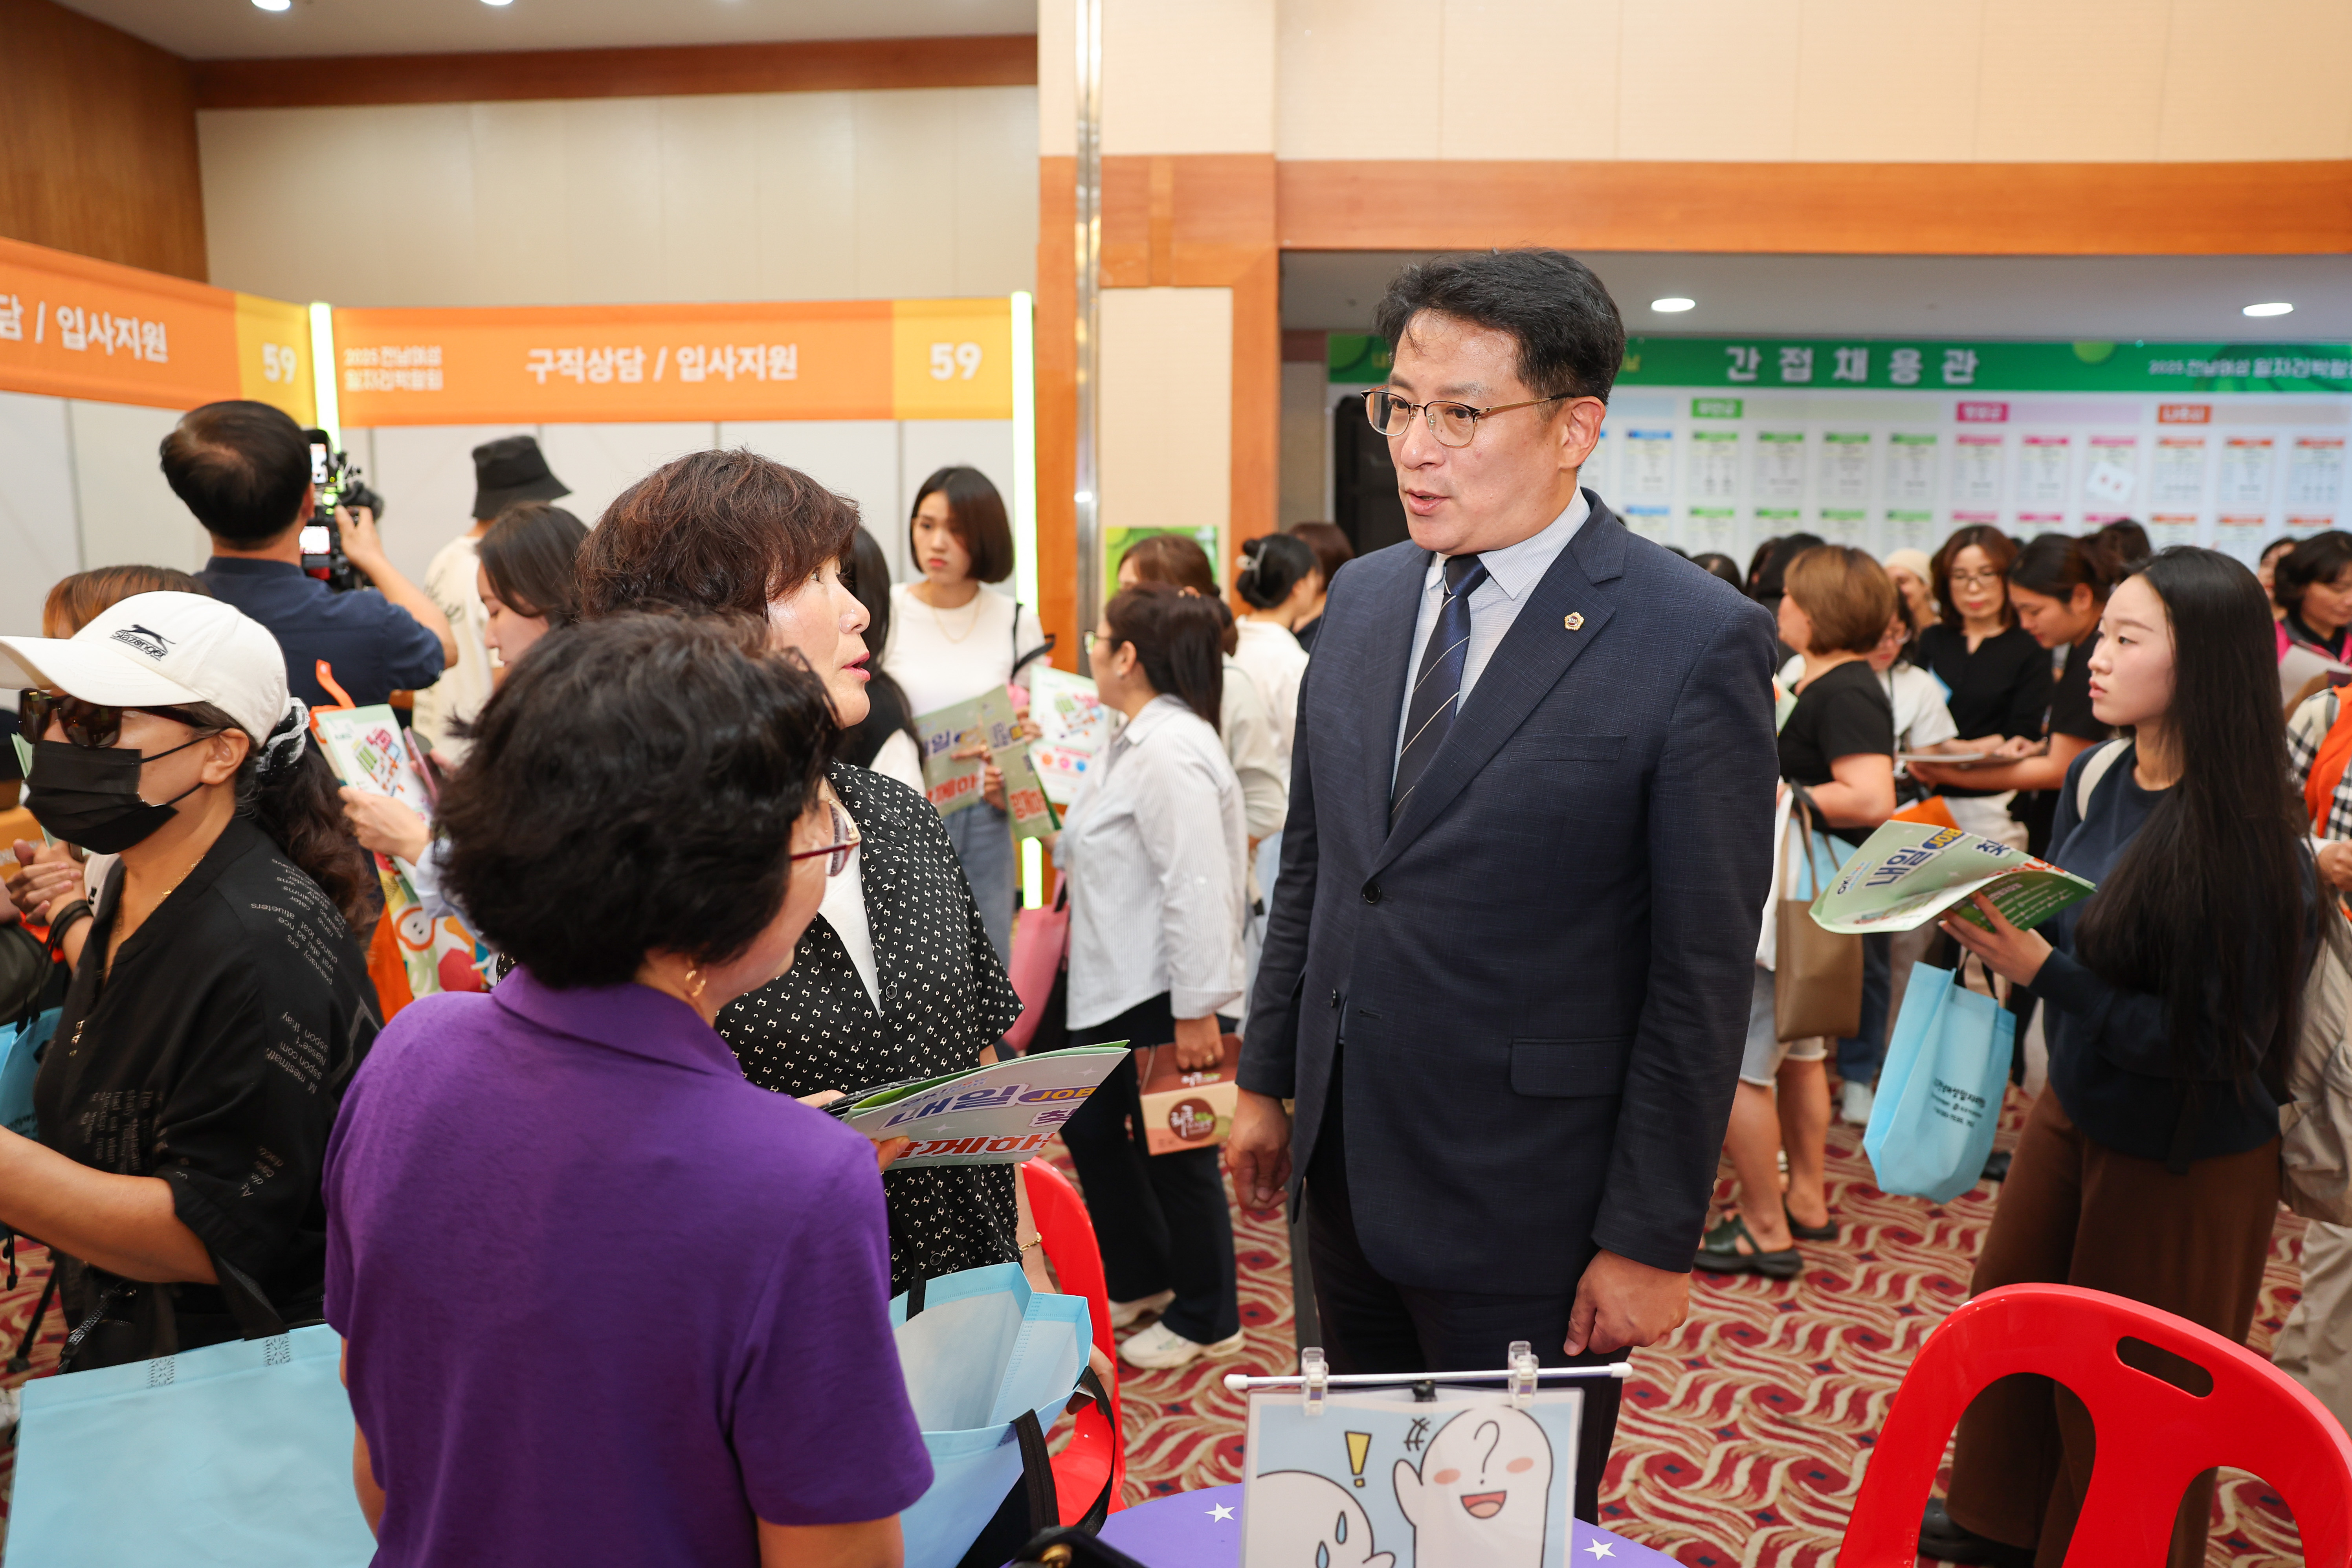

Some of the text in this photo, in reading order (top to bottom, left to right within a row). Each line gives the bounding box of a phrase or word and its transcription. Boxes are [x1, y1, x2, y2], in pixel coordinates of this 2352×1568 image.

[35, 301, 46, 344] /
[56, 305, 168, 363] 입사지원
[262, 343, 297, 383] 59
[526, 343, 798, 384] 구직상담 / 입사지원
[930, 341, 982, 380] 59
[112, 630, 166, 659] Slazenger
[1866, 849, 1934, 886] 내일
[1929, 828, 1962, 848] JOB
[280, 1041, 298, 1059] com
[884, 1085, 1020, 1128] 내일
[1029, 1087, 1097, 1101] JOB
[897, 1132, 1057, 1159] 께하
